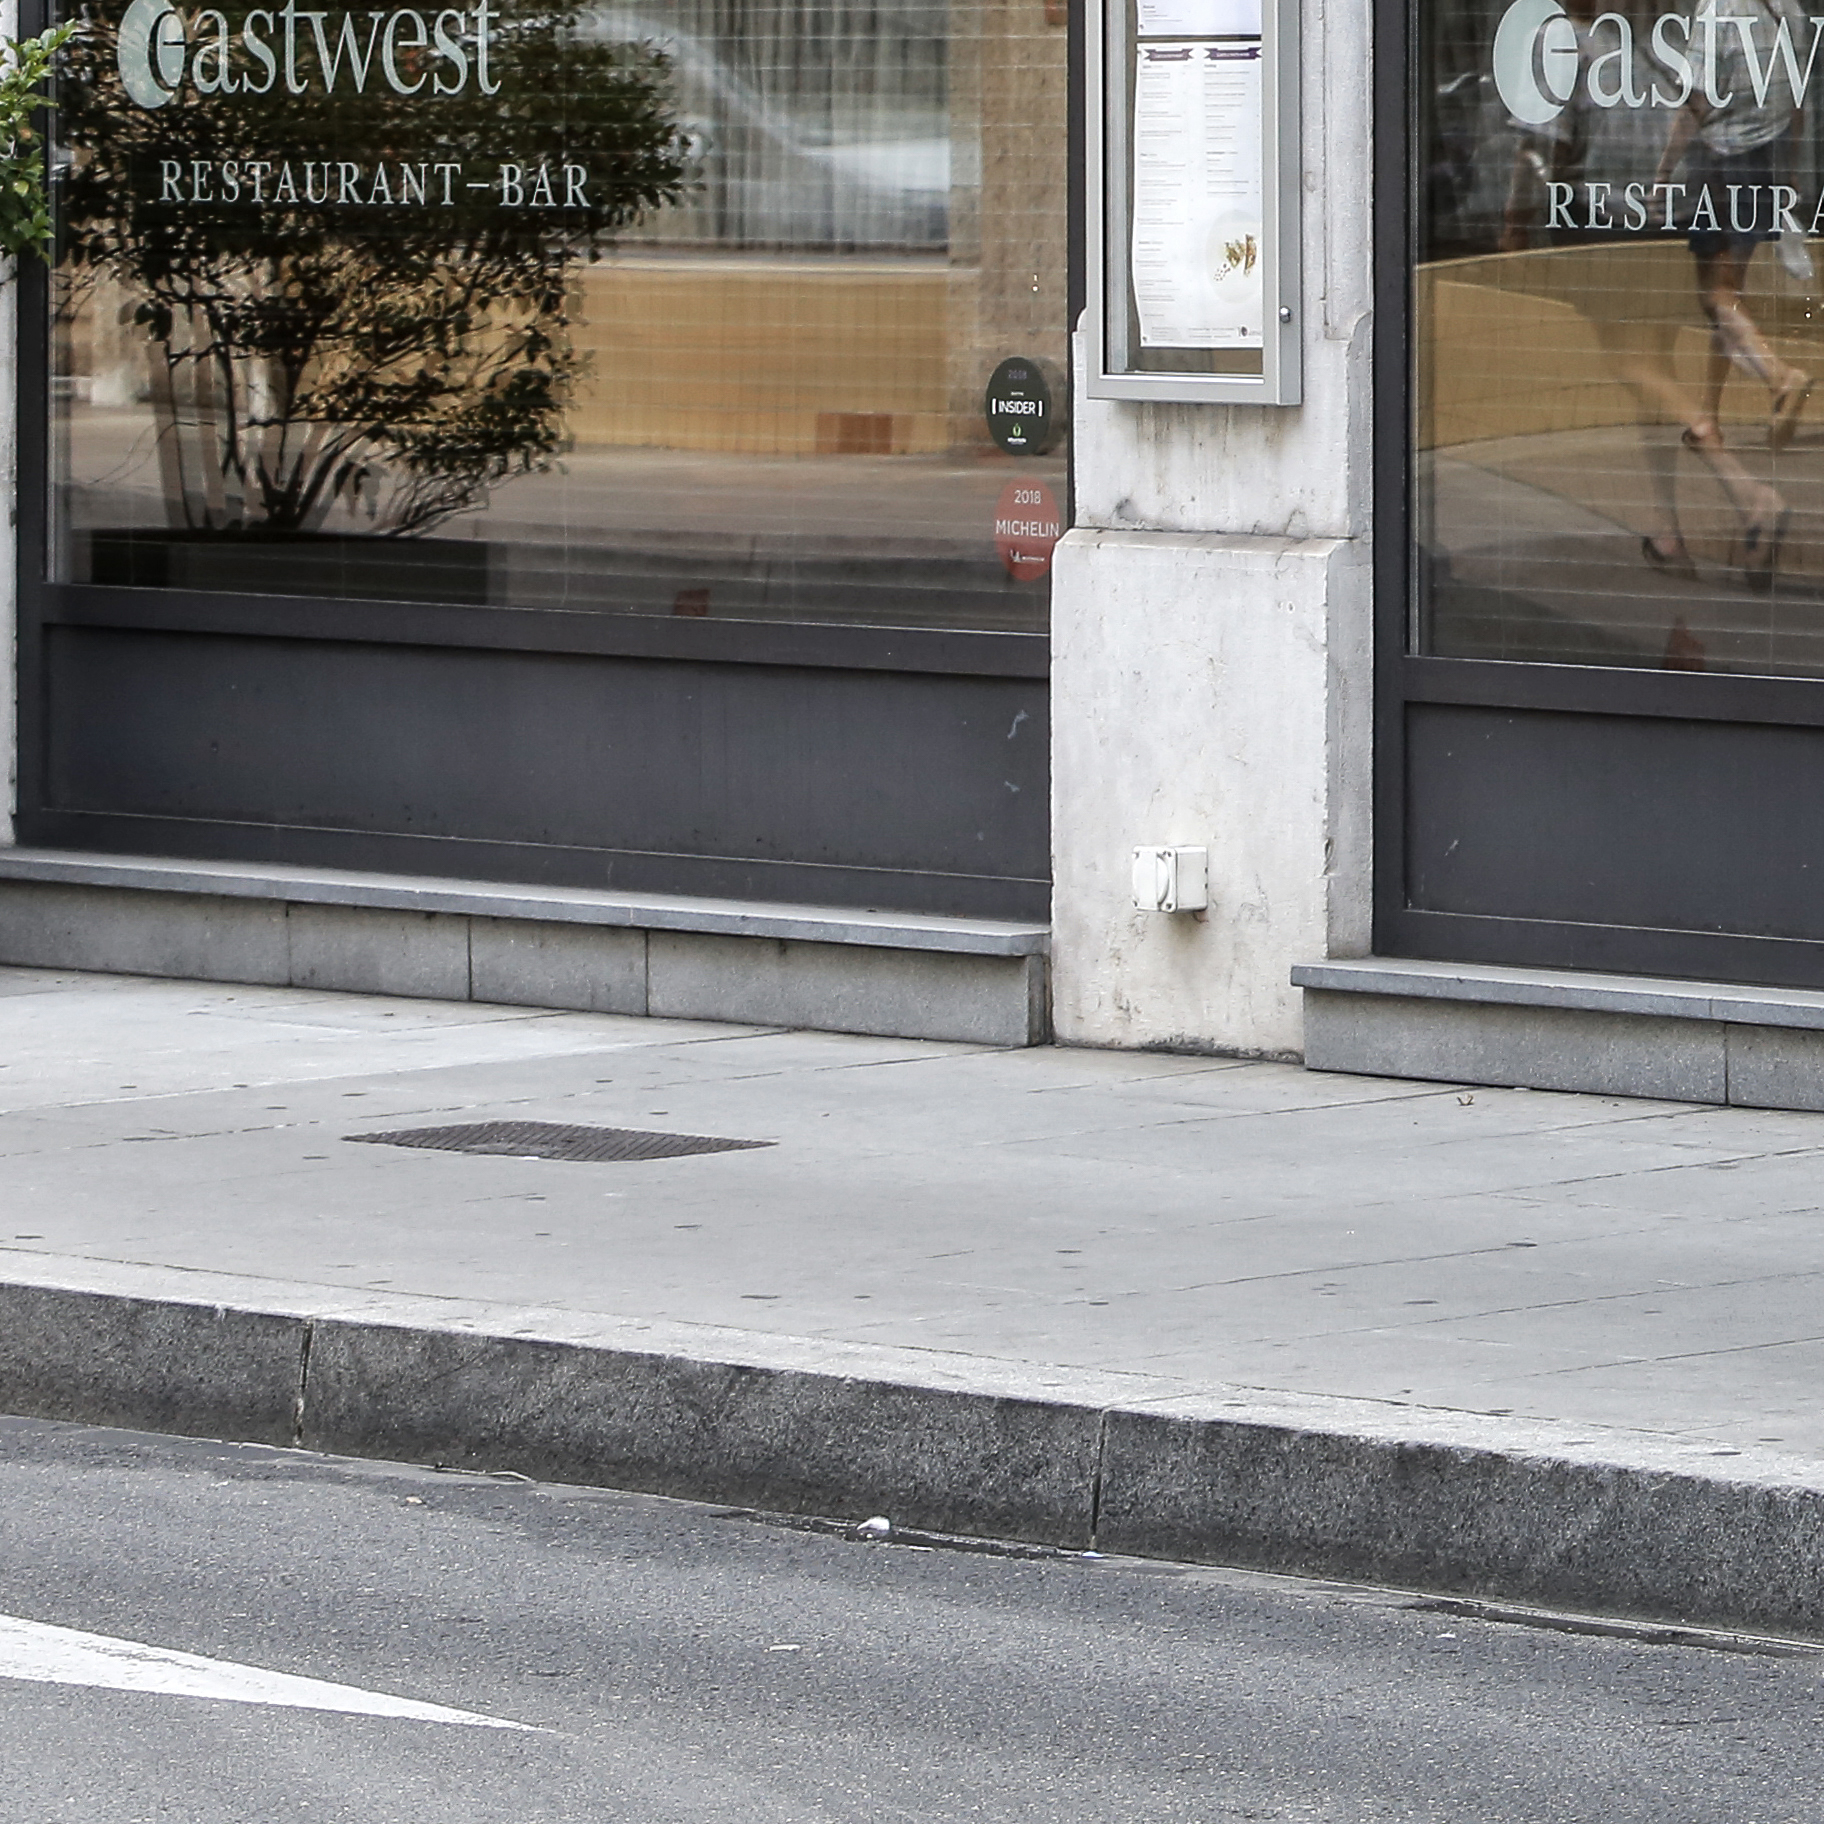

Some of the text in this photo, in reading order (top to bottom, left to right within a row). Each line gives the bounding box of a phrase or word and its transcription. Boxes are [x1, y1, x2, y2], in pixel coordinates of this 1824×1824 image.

[998, 399, 1036, 416] INSIDER
[1014, 489, 1042, 504] 2018
[995, 519, 1060, 538] MICHELIN
